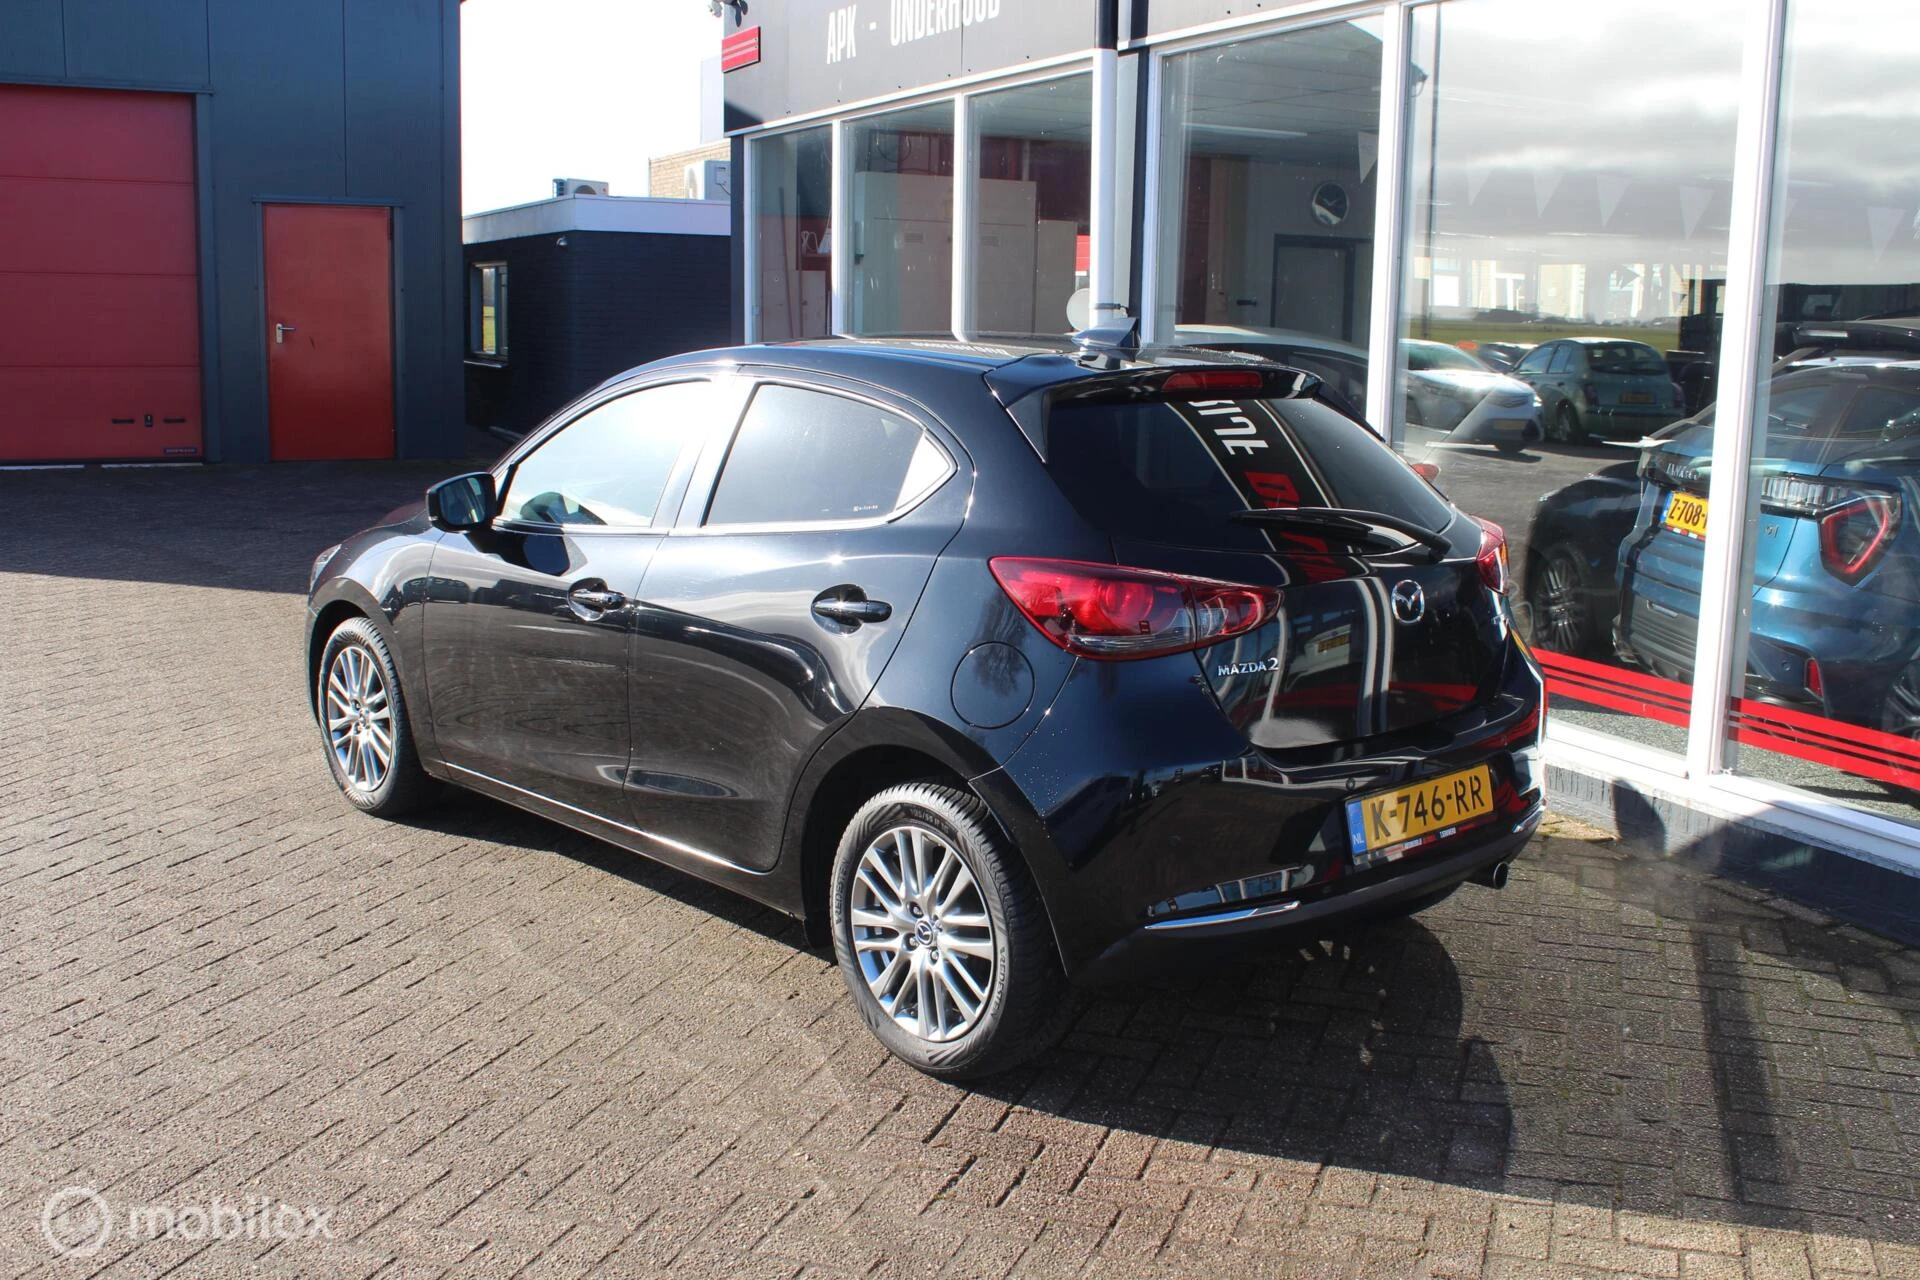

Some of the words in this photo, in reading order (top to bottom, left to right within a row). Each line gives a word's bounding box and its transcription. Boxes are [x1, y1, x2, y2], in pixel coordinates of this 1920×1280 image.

[826, 4, 857, 65] APK
[1370, 775, 1485, 841] K-746-RR
[1352, 833, 1364, 845] NL
